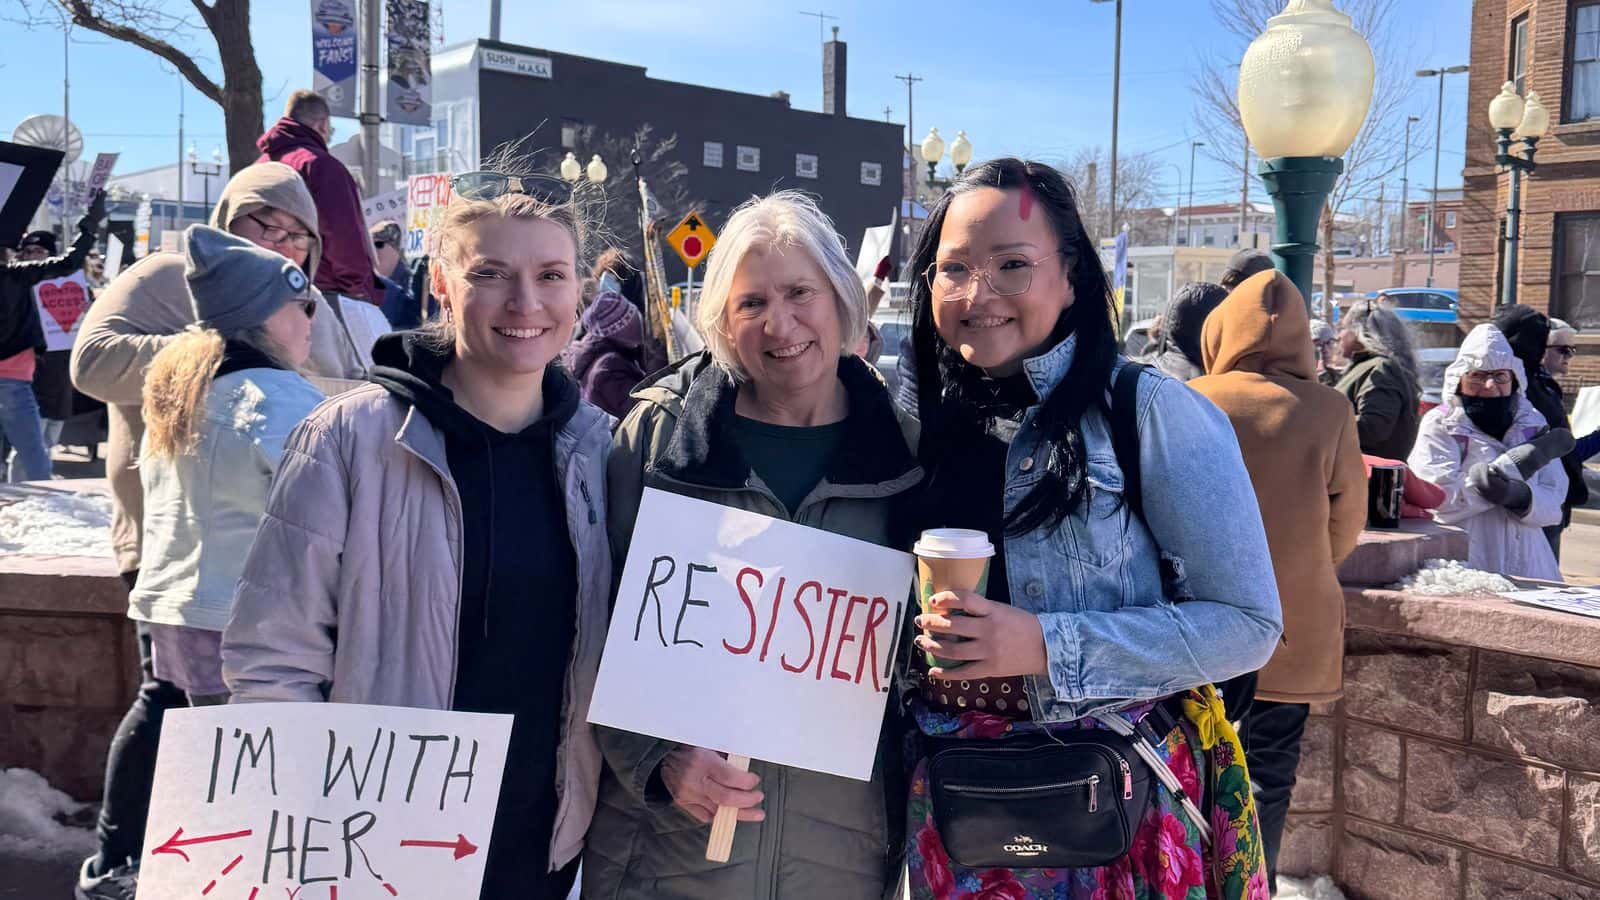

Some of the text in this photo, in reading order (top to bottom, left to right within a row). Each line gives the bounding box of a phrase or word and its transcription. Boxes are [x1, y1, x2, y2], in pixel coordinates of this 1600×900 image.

[319, 47, 354, 67] FANS!
[487, 52, 515, 65] SUSHI
[634, 555, 903, 693] RESISTER!
[207, 726, 479, 810] I'M WITH
[262, 809, 383, 884] HER
[1003, 844, 1048, 853] COACH
